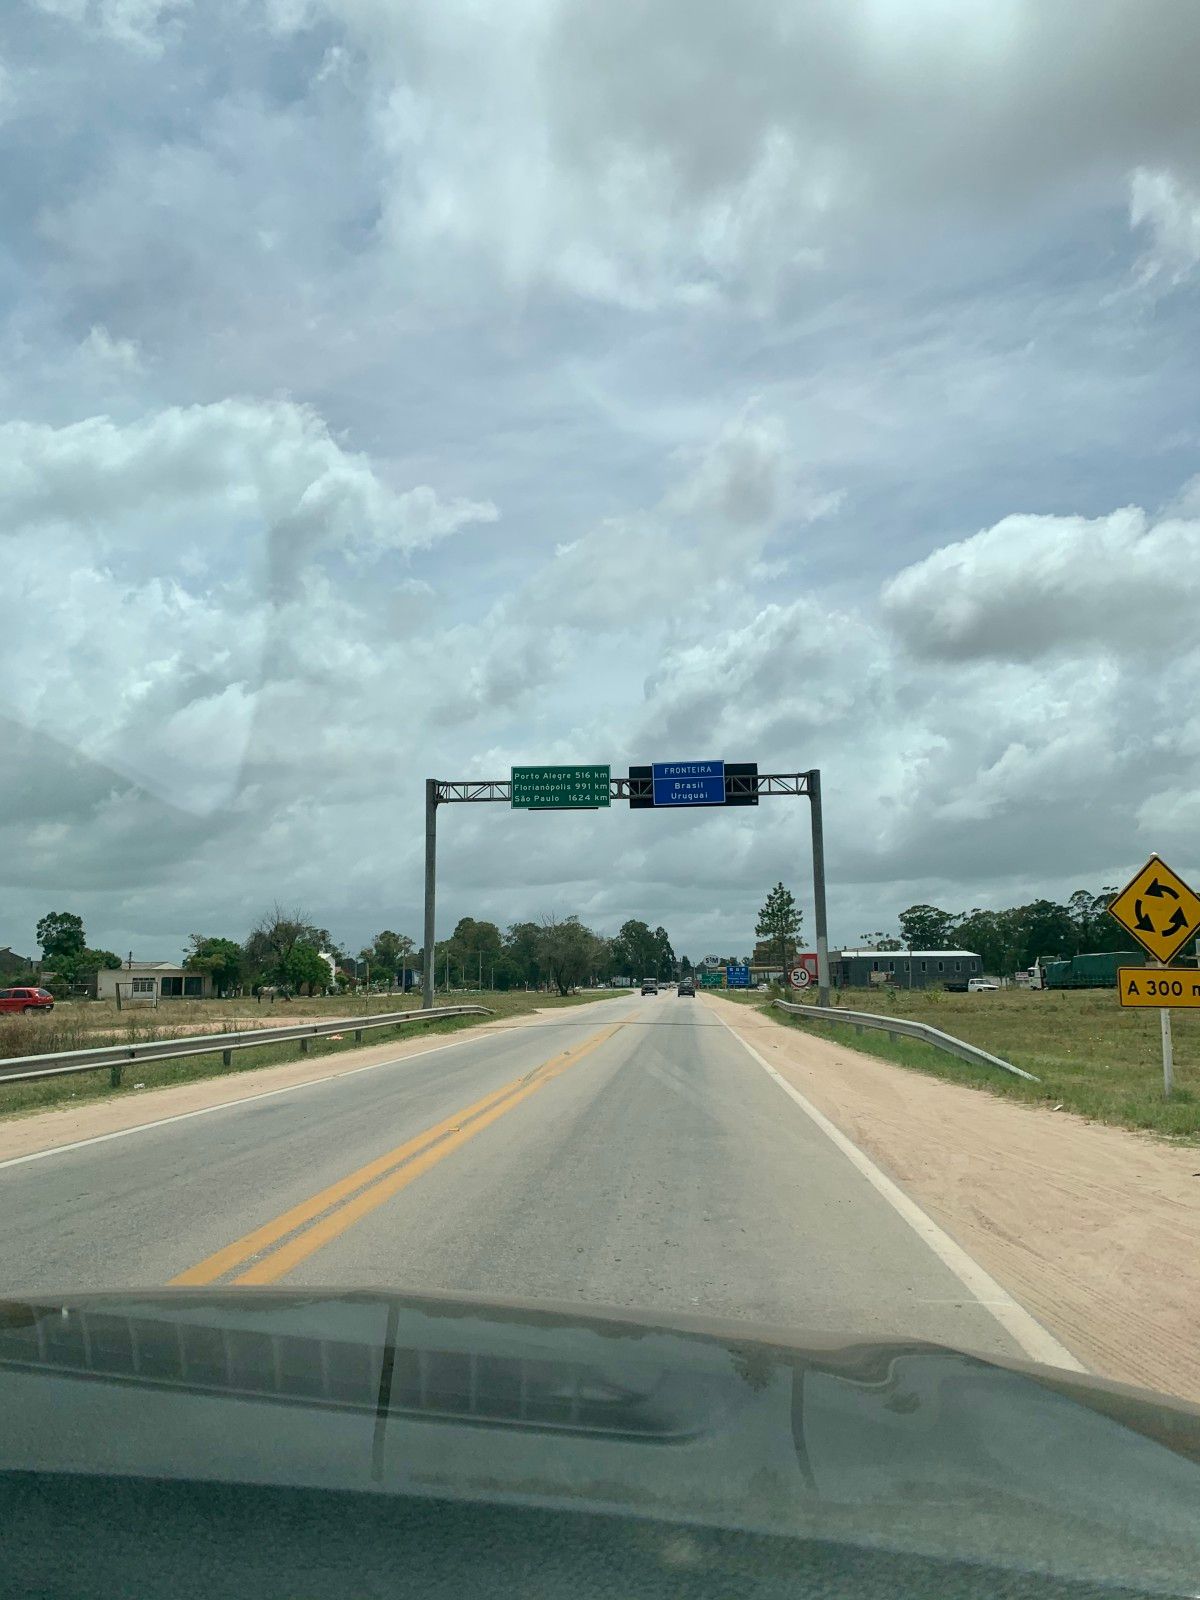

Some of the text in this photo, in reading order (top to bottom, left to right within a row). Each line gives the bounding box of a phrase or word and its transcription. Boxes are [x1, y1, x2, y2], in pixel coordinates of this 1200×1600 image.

[664, 766, 712, 775] FRONTEIRA
[542, 772, 571, 780] Alegre
[575, 771, 591, 779] 516
[514, 783, 571, 791] Florianópolis
[674, 781, 704, 790] Brasil
[671, 791, 708, 800] Uruguai
[793, 971, 807, 981] 50
[1127, 980, 1140, 995] A
[1146, 980, 1183, 996] 300
